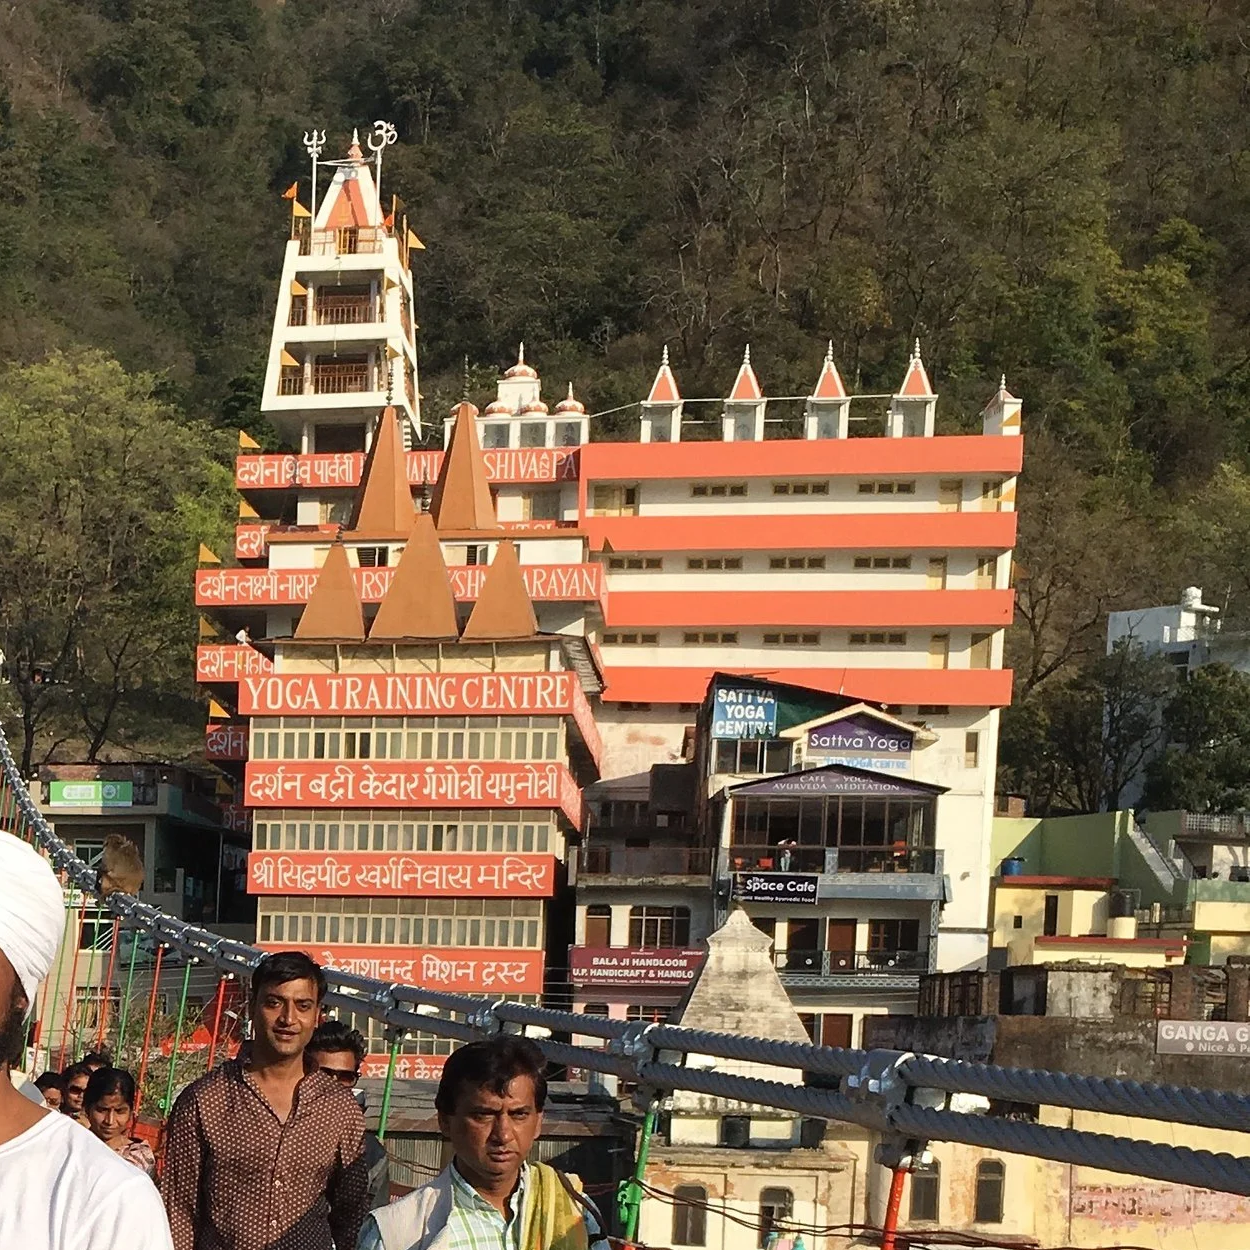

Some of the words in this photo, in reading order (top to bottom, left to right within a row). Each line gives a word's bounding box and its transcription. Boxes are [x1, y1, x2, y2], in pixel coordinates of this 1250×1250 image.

[237, 456, 278, 485] दर्शन
[281, 455, 311, 484] शिव
[314, 453, 353, 483] पार्वती
[483, 451, 539, 480] SHIVA
[236, 526, 269, 556] दर्श
[198, 570, 237, 601] दर्शन
[238, 569, 279, 600] लक्ष्मी
[197, 646, 238, 679] दर्शन
[245, 676, 322, 710] YOGA
[327, 676, 457, 710] TRAINING
[462, 675, 571, 709] CENTRE
[717, 688, 775, 704] SATTVA
[725, 705, 765, 720] YOGA
[207, 726, 245, 756] दर्शन
[715, 721, 774, 739] CENTRE
[810, 734, 863, 749] Sattva
[867, 735, 911, 752] Yoga
[250, 766, 307, 801] दर्शन
[309, 765, 356, 802] बद्री
[359, 764, 419, 801] केदार
[422, 765, 485, 800] गंगोत्री
[485, 765, 558, 805] यमुनोत्री
[835, 783, 900, 791] MEDITATION
[252, 857, 275, 889] श्री
[477, 857, 547, 890] मन्दिर
[745, 879, 784, 892] Space
[786, 881, 816, 892] Cafe
[421, 953, 478, 984] मिशन
[482, 961, 531, 986] ट्रस्ट
[572, 968, 588, 977] U.P.
[590, 969, 646, 978] HANDICRAFT
[648, 969, 656, 978] &
[592, 957, 618, 966] BALA
[620, 957, 630, 967] JI
[632, 958, 687, 967] HANDLOOM
[1161, 1024, 1230, 1042] GANGA
[1198, 1042, 1224, 1053] Nice
[1227, 1043, 1237, 1053] &
